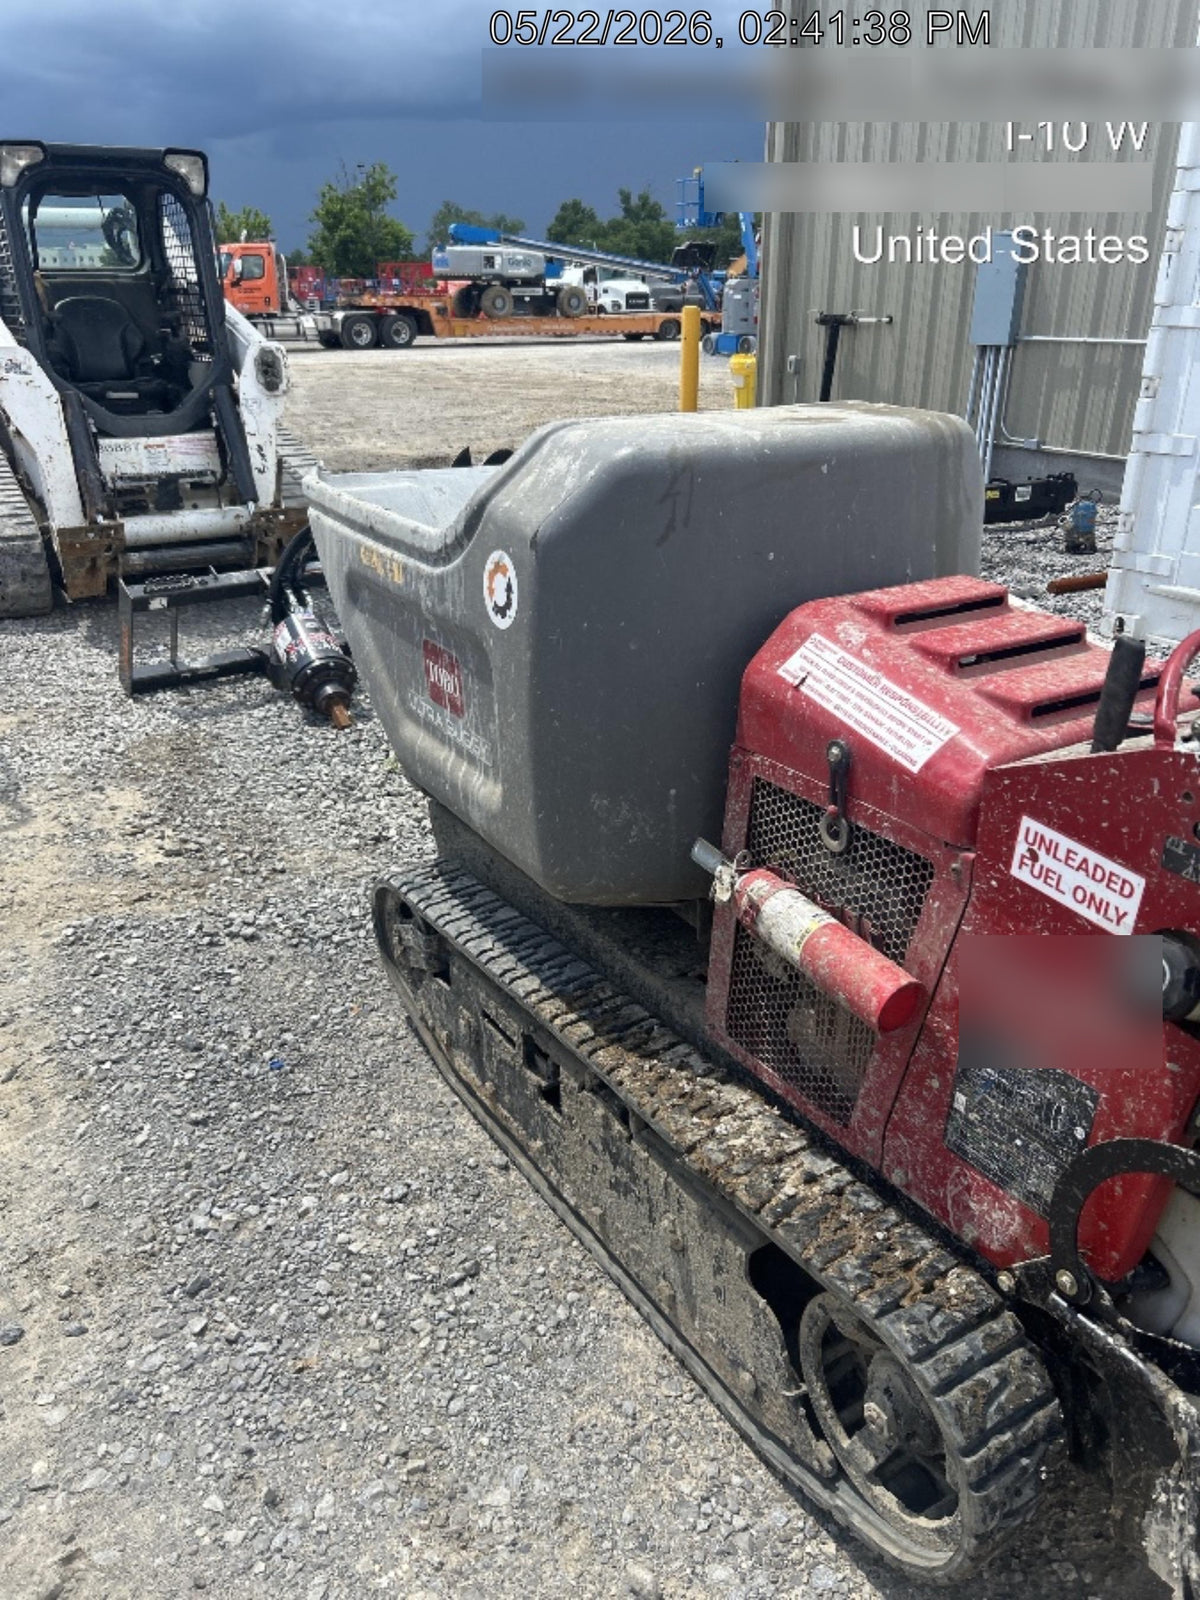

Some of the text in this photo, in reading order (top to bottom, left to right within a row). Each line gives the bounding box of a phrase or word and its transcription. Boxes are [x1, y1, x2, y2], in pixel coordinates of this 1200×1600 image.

[1018, 853, 1128, 927] FUEL ONLY
[1024, 826, 1135, 899] UNLEADED
